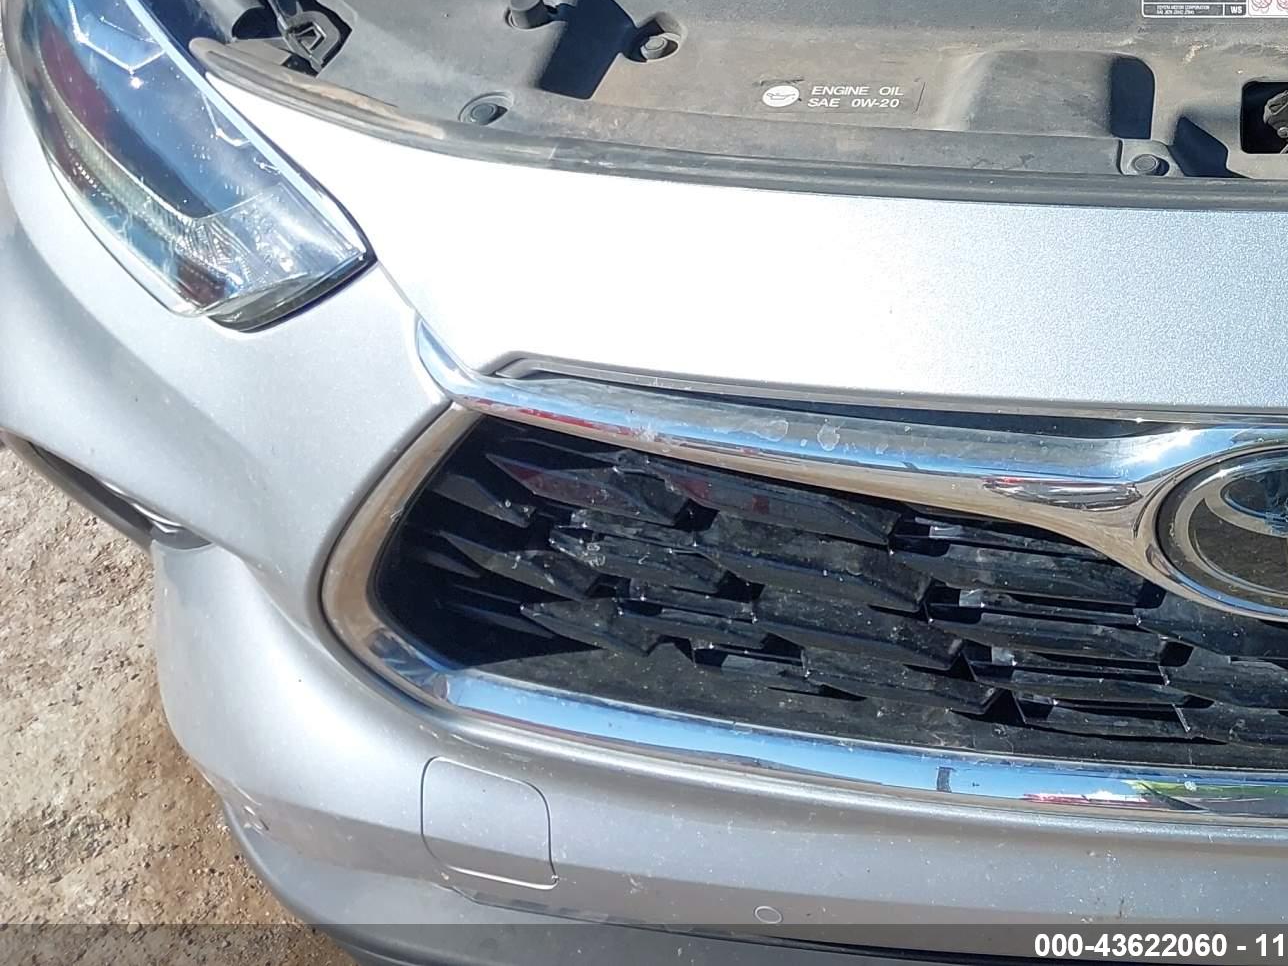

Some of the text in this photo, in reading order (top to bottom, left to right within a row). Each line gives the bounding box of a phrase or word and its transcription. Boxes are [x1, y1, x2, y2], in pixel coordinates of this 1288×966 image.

[1230, 5, 1243, 14] WS
[811, 85, 905, 96] ENGINE OIL
[807, 97, 900, 108] SAE 0W-20
